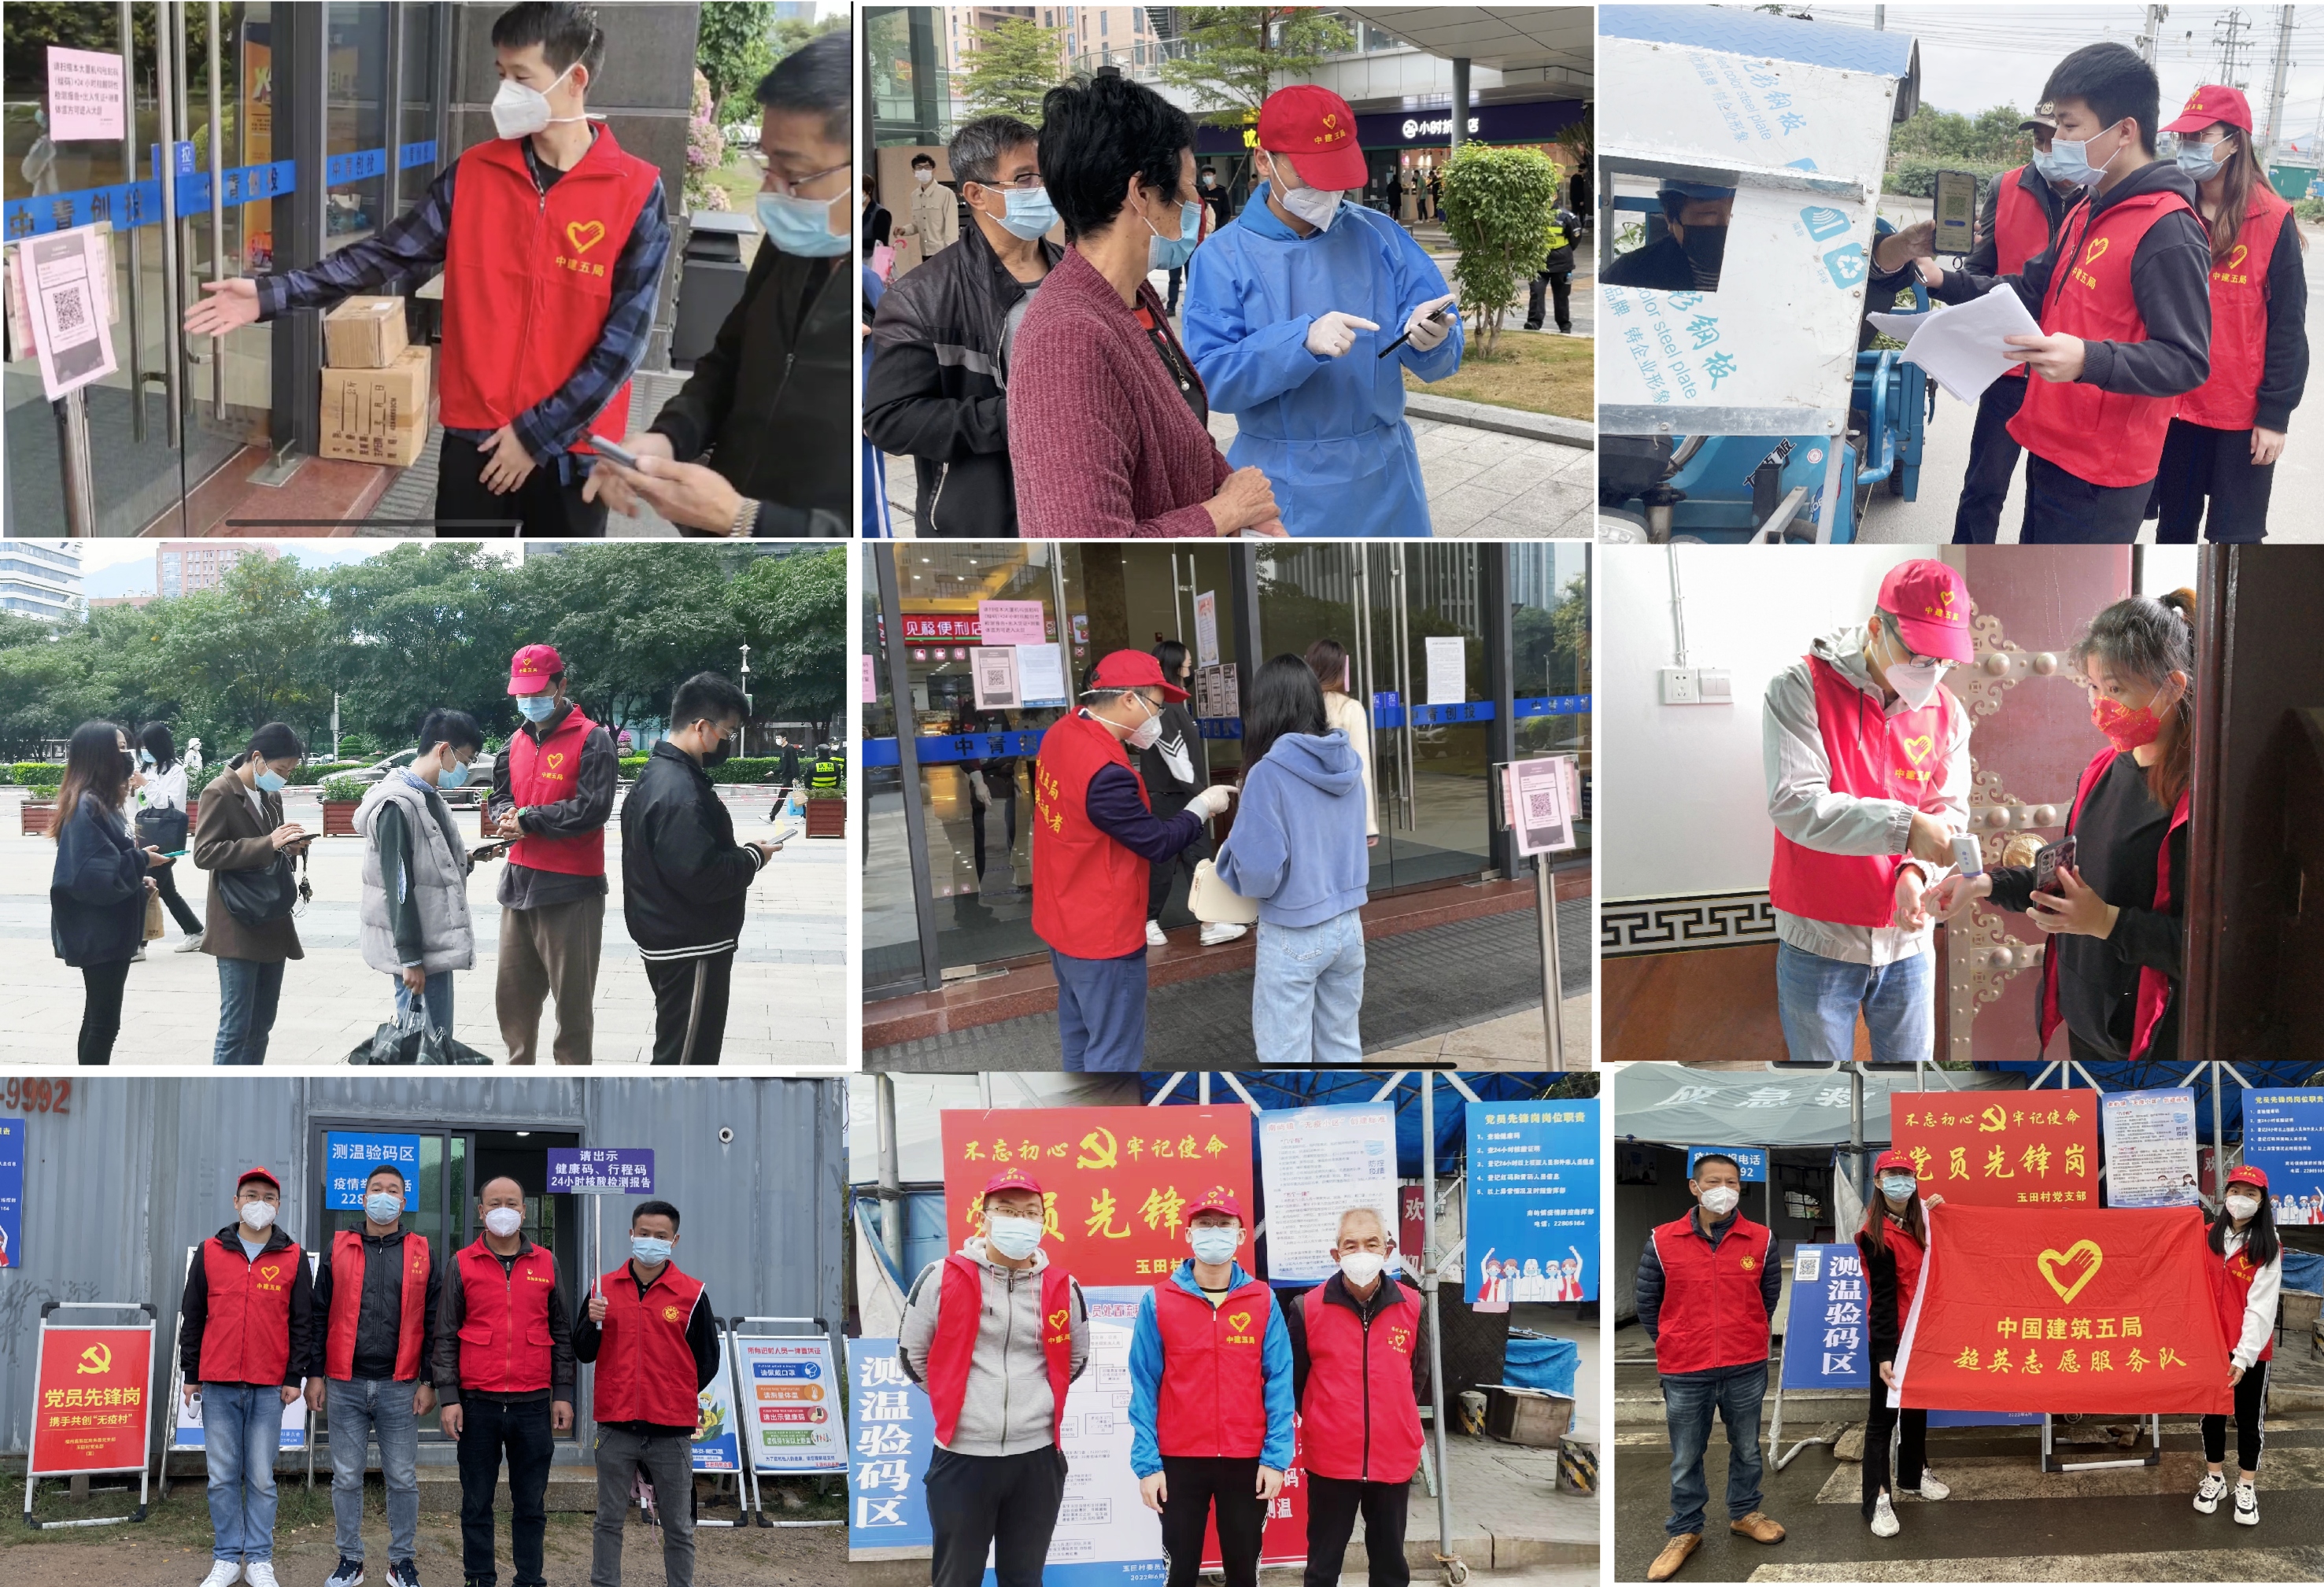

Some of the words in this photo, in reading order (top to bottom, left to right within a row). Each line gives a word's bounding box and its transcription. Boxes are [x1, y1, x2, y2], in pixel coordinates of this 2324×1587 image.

[1724, 69, 1743, 89] color
[1736, 90, 1761, 113] steel
[1418, 117, 1480, 135] 小时折店
[1747, 114, 1772, 141] plate
[1314, 131, 1346, 145] 中建五局
[182, 146, 192, 162] 拉
[556, 255, 604, 277] 中建五局
[2072, 267, 2097, 290] 中建五局
[2212, 271, 2247, 285] 中建五局
[1624, 327, 1671, 405] 铸企业形象
[1653, 321, 1683, 359] steel
[1668, 360, 1697, 399] plate
[1925, 606, 1959, 622] 中建五局
[907, 621, 982, 636] 见福便利店
[1387, 693, 1396, 703] 拉
[541, 772, 563, 781] 中建五局
[1654, 1086, 1876, 1108] 应急救
[1350, 1115, 1387, 1125] 创建标准
[1485, 1112, 1585, 1124] 党员先锋岗岗位职责
[1905, 1111, 1975, 1128] 不忘初心
[2012, 1108, 2081, 1128] 牢记使命
[332, 1143, 415, 1162] 测温验码区
[580, 1150, 618, 1161] 请出示
[964, 1139, 1068, 1162] 不忘初心
[1127, 1134, 1229, 1161] 牢记使命
[555, 1163, 647, 1175] 健康码、行程码
[1908, 1142, 2085, 1181] 党员先锋岗
[551, 1175, 651, 1188] 24小时核酸检测报告
[2017, 1190, 2087, 1202] 玉田村党支部
[257, 1283, 281, 1291] 中建五局
[1821, 1256, 1864, 1375] 测温验码区
[1997, 1316, 2143, 1340] 中国建筑五局
[1226, 1335, 1255, 1344] 中建五局
[1953, 1346, 2187, 1374] 超英志愿服务队
[44, 1387, 140, 1408] 党员先锋岗
[855, 1356, 914, 1529] 测温验码区
